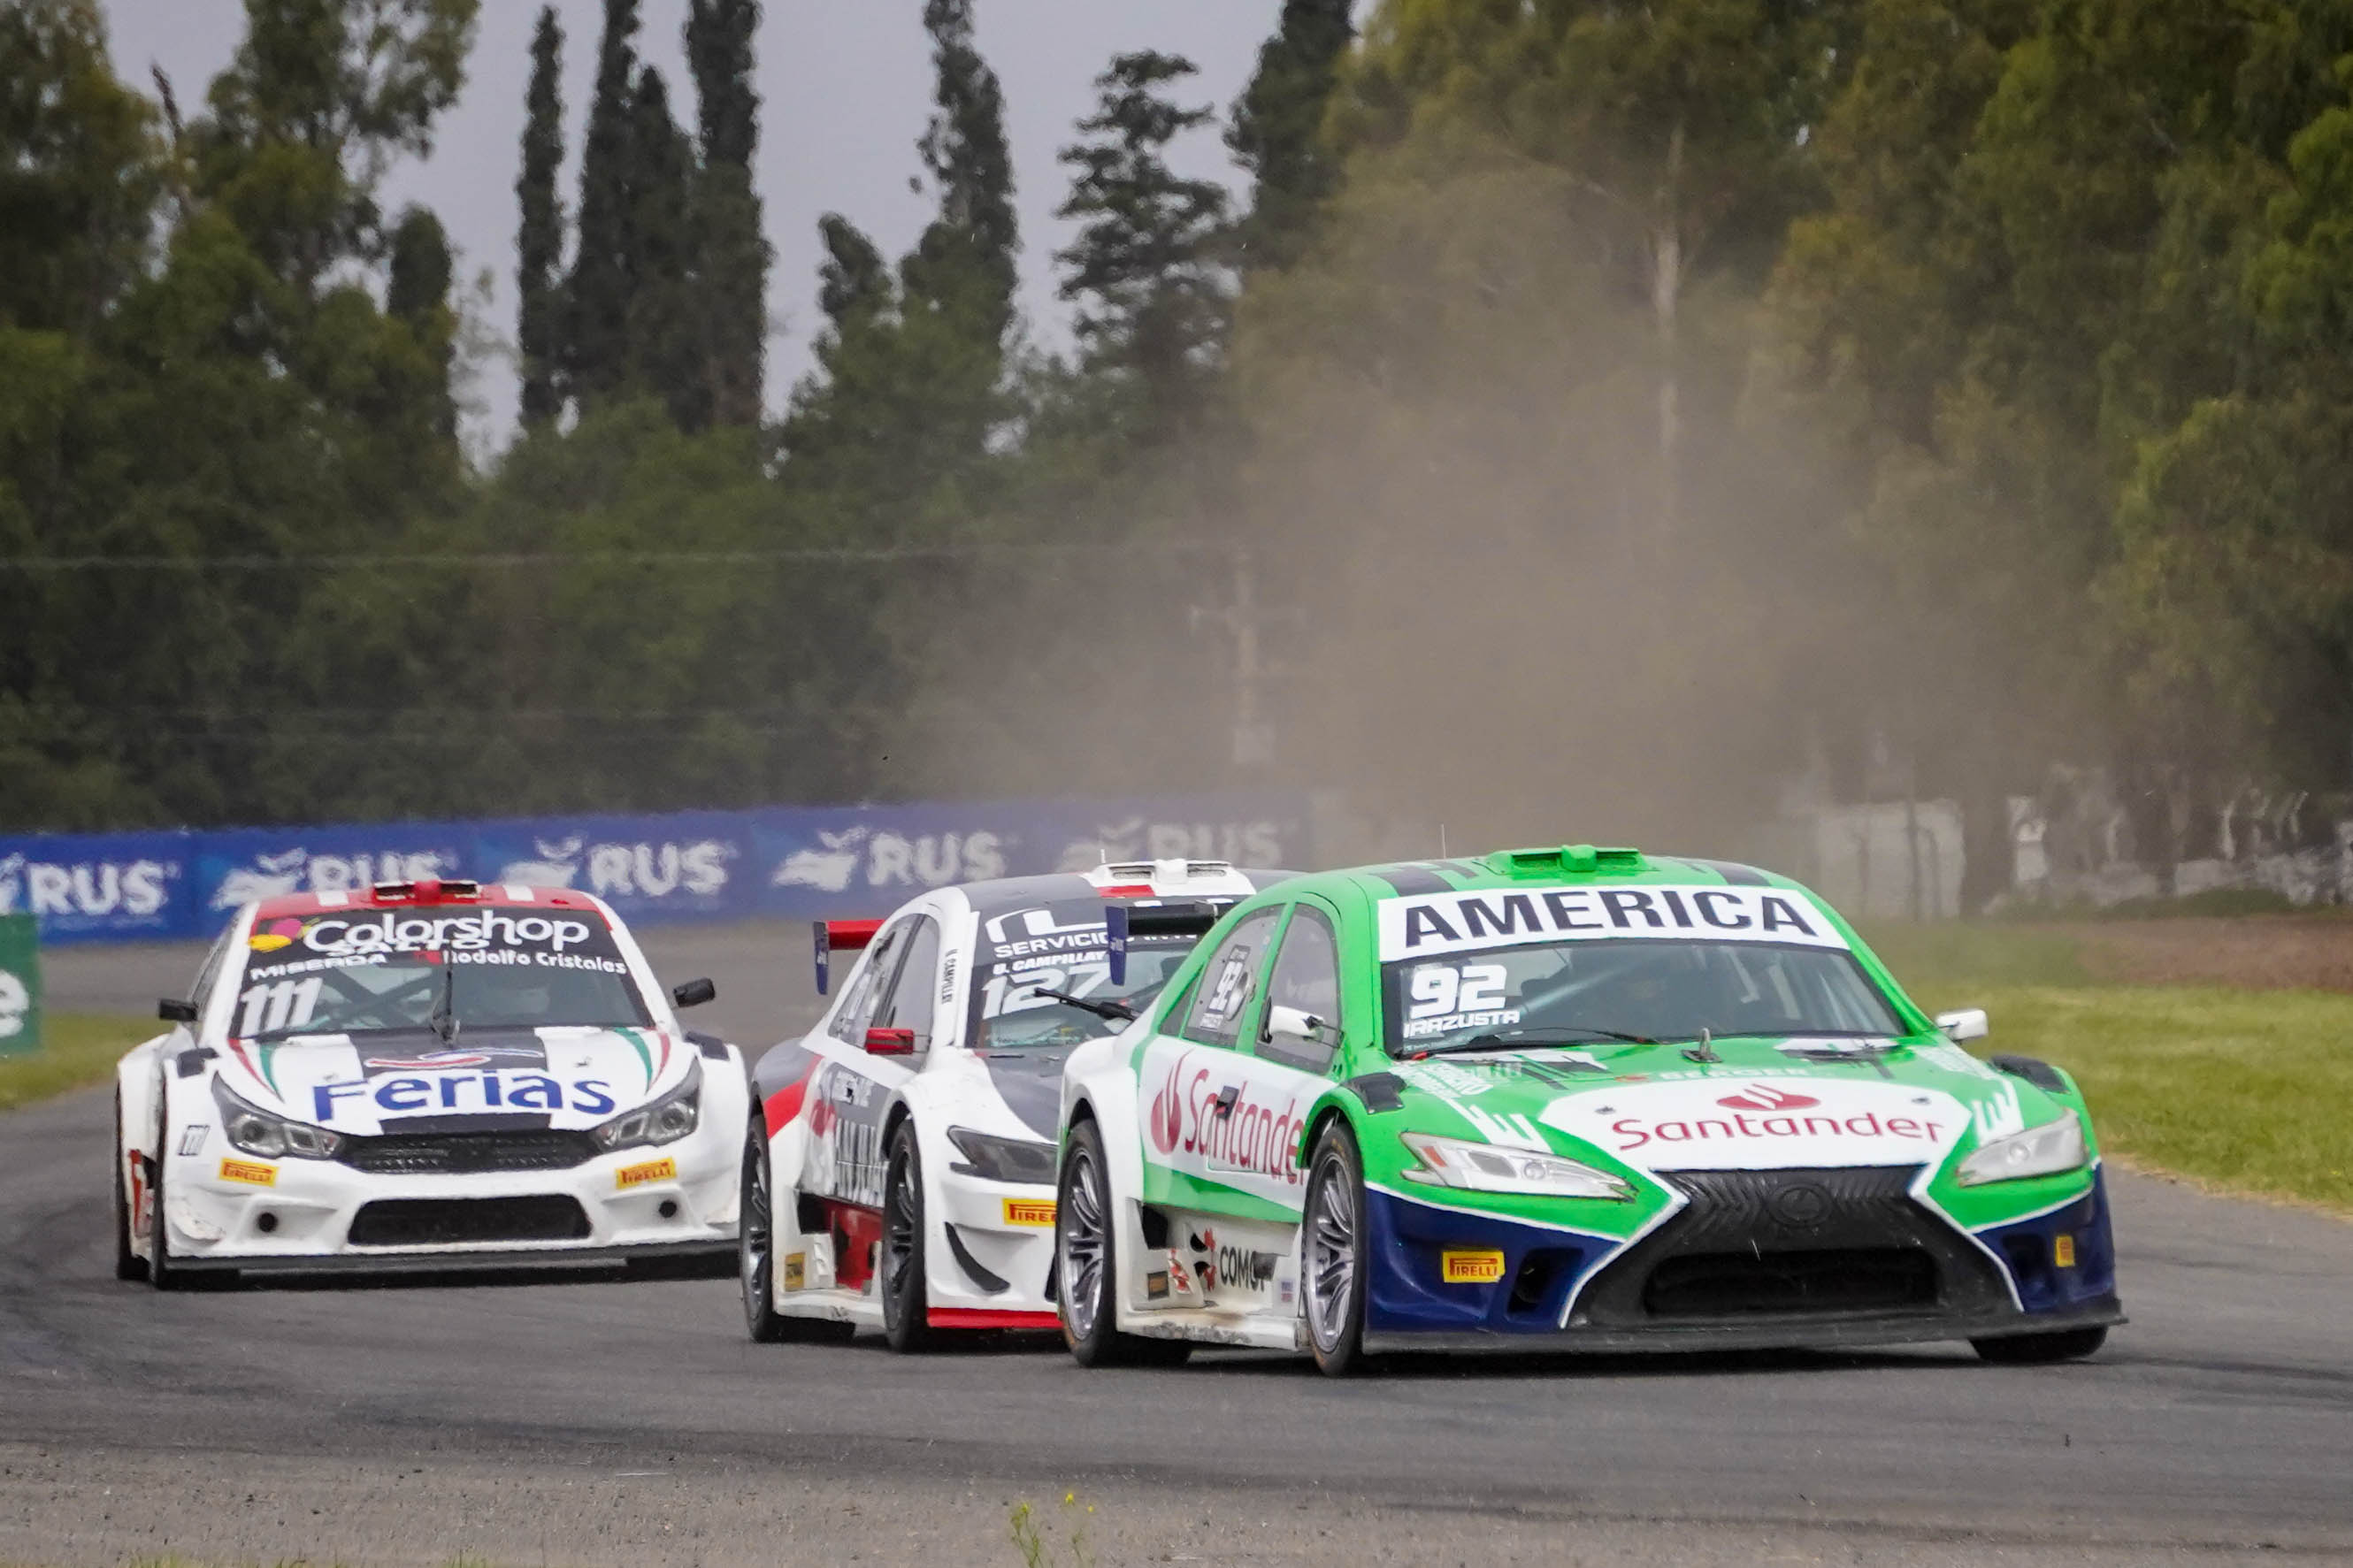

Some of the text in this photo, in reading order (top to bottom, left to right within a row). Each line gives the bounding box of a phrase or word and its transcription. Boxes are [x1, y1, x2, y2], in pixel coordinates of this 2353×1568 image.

[588, 841, 728, 897] RUS
[867, 830, 1007, 885] RUS
[29, 859, 168, 915] RUS
[303, 909, 590, 952] Colorshop
[993, 932, 1108, 959] SERVICI
[1406, 890, 1819, 948] AMERICA
[535, 952, 627, 975] Cristales
[980, 961, 1110, 1020] 127
[240, 976, 323, 1038] 111
[1410, 964, 1507, 1020] 92
[1403, 1010, 1521, 1039] IRAZUSTA
[313, 1068, 617, 1122] Ferias
[1612, 1112, 1945, 1151] Santander
[621, 1160, 671, 1183] PIRELLI
[1449, 1257, 1498, 1276] PIRELLI
